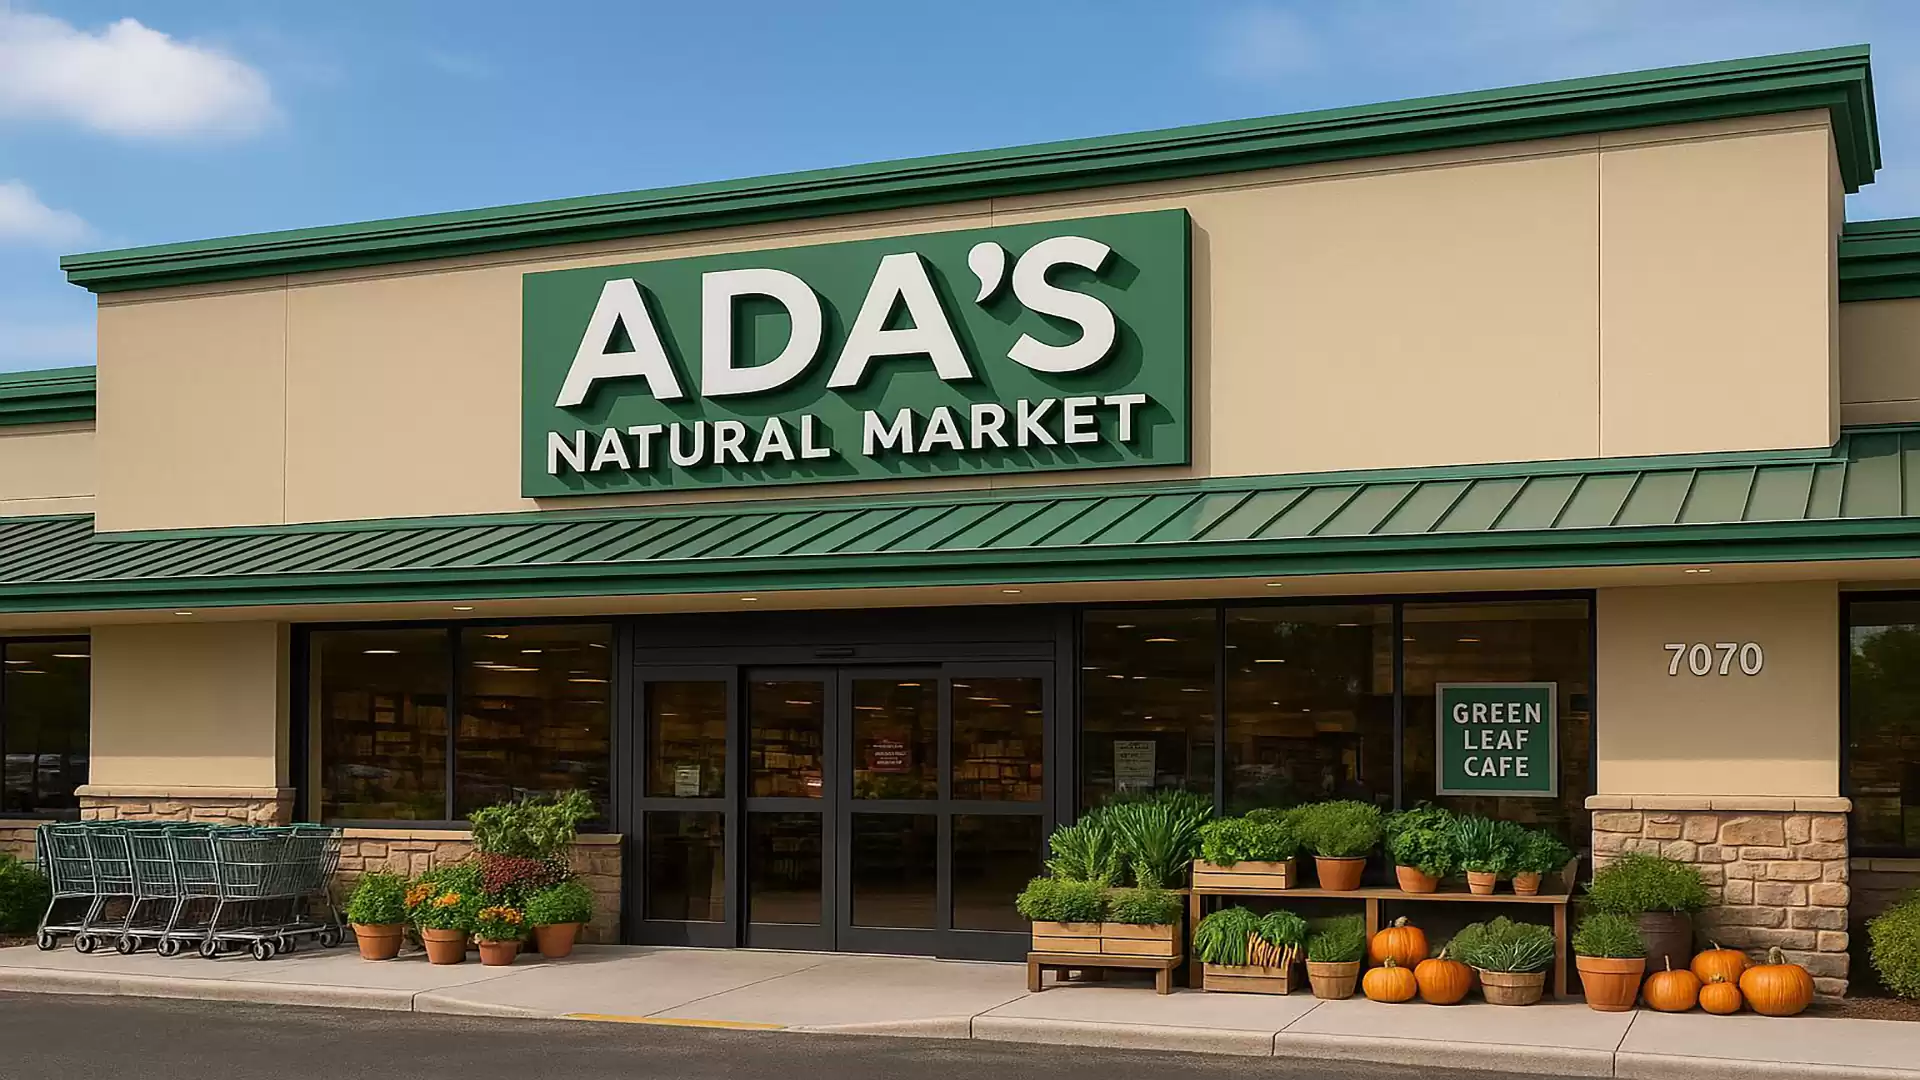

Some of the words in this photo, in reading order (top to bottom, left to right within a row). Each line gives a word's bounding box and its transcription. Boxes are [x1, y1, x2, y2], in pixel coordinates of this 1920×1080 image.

[555, 235, 1117, 408] ADA'S
[547, 414, 831, 475] NATURAL
[862, 393, 1147, 456] MARKET
[1664, 642, 1764, 677] 7070
[1453, 702, 1541, 724] GREEN
[1464, 729, 1529, 750] LEAF
[1464, 756, 1529, 777] CAFE
